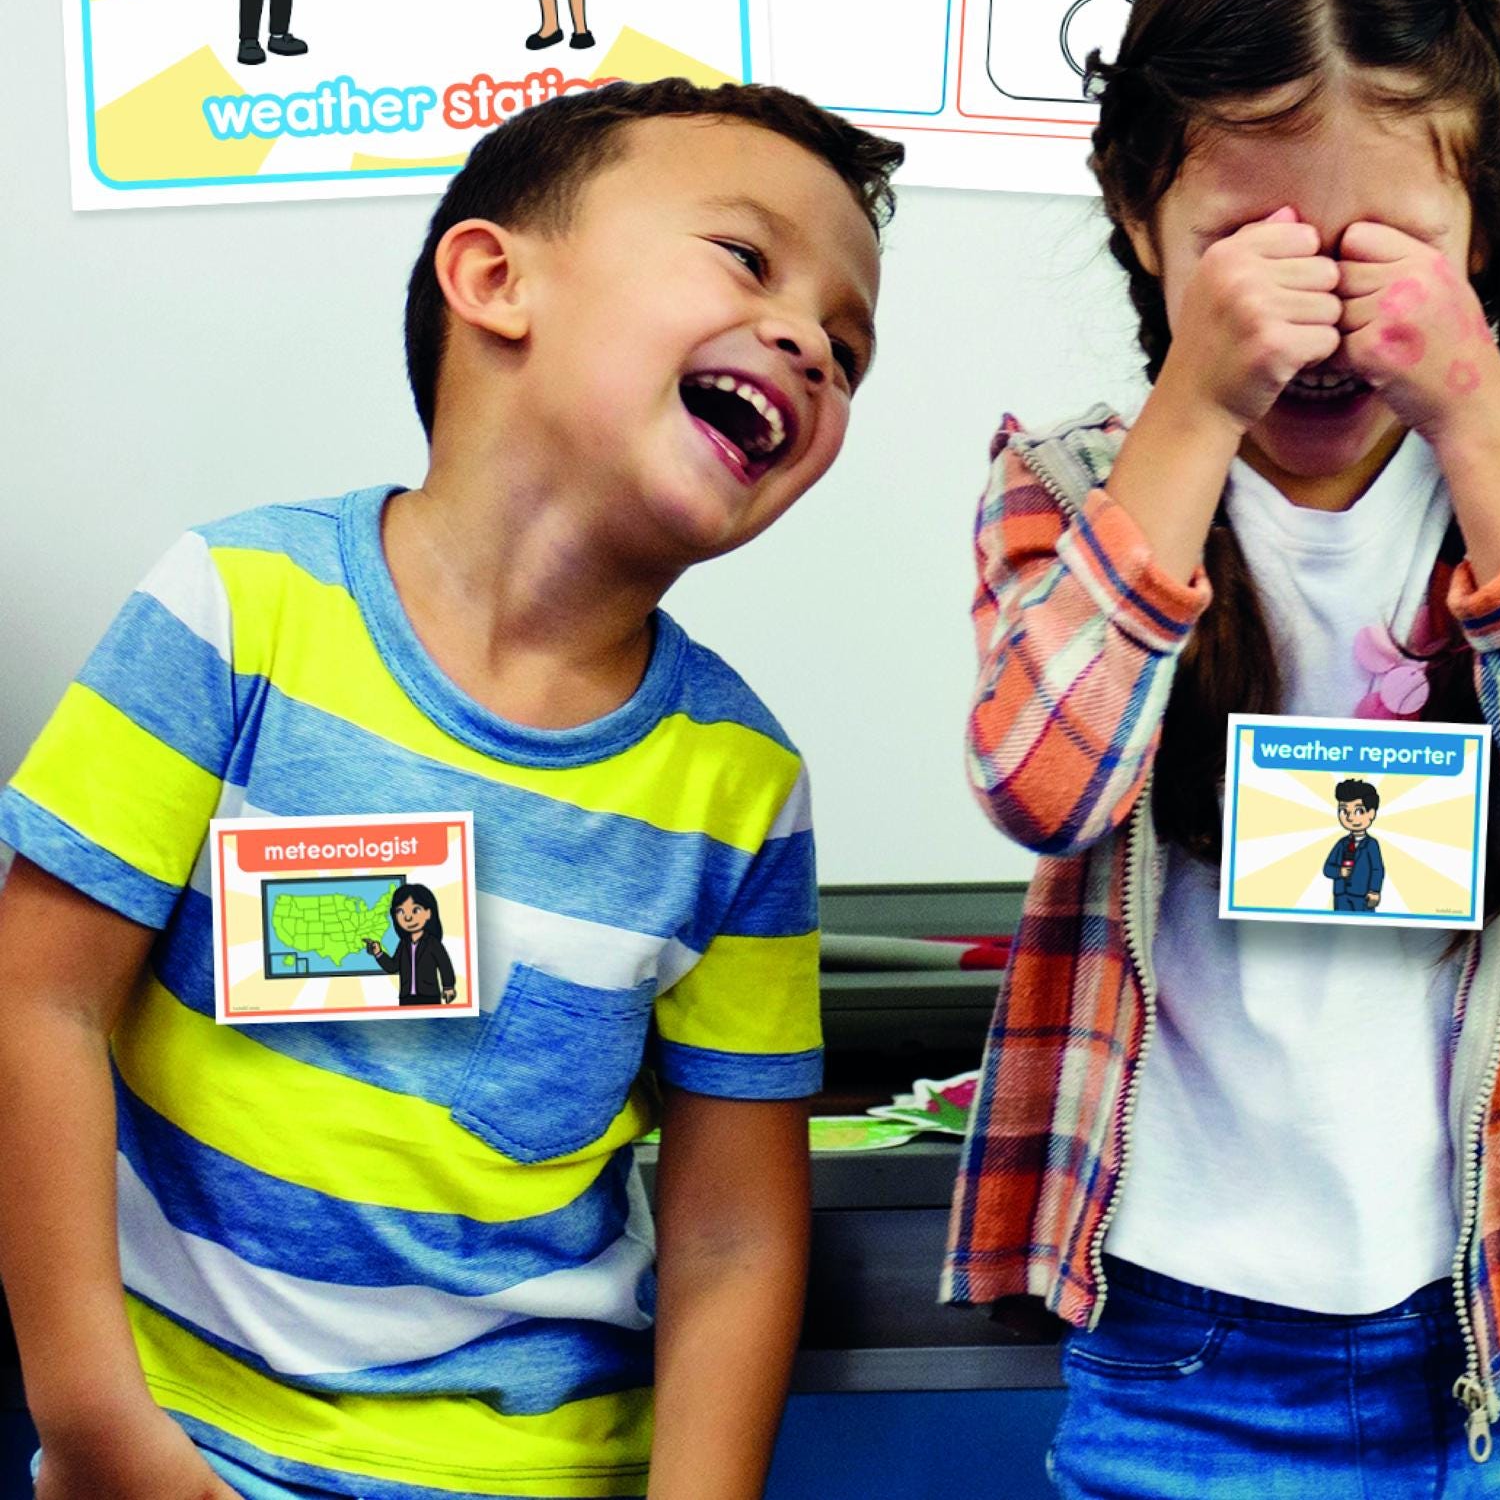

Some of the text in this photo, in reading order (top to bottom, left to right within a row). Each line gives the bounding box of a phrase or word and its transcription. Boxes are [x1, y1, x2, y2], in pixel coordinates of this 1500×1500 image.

[203, 68, 624, 142] weather stati
[1260, 741, 1457, 769] weather reporter
[264, 836, 419, 862] meteorologist
